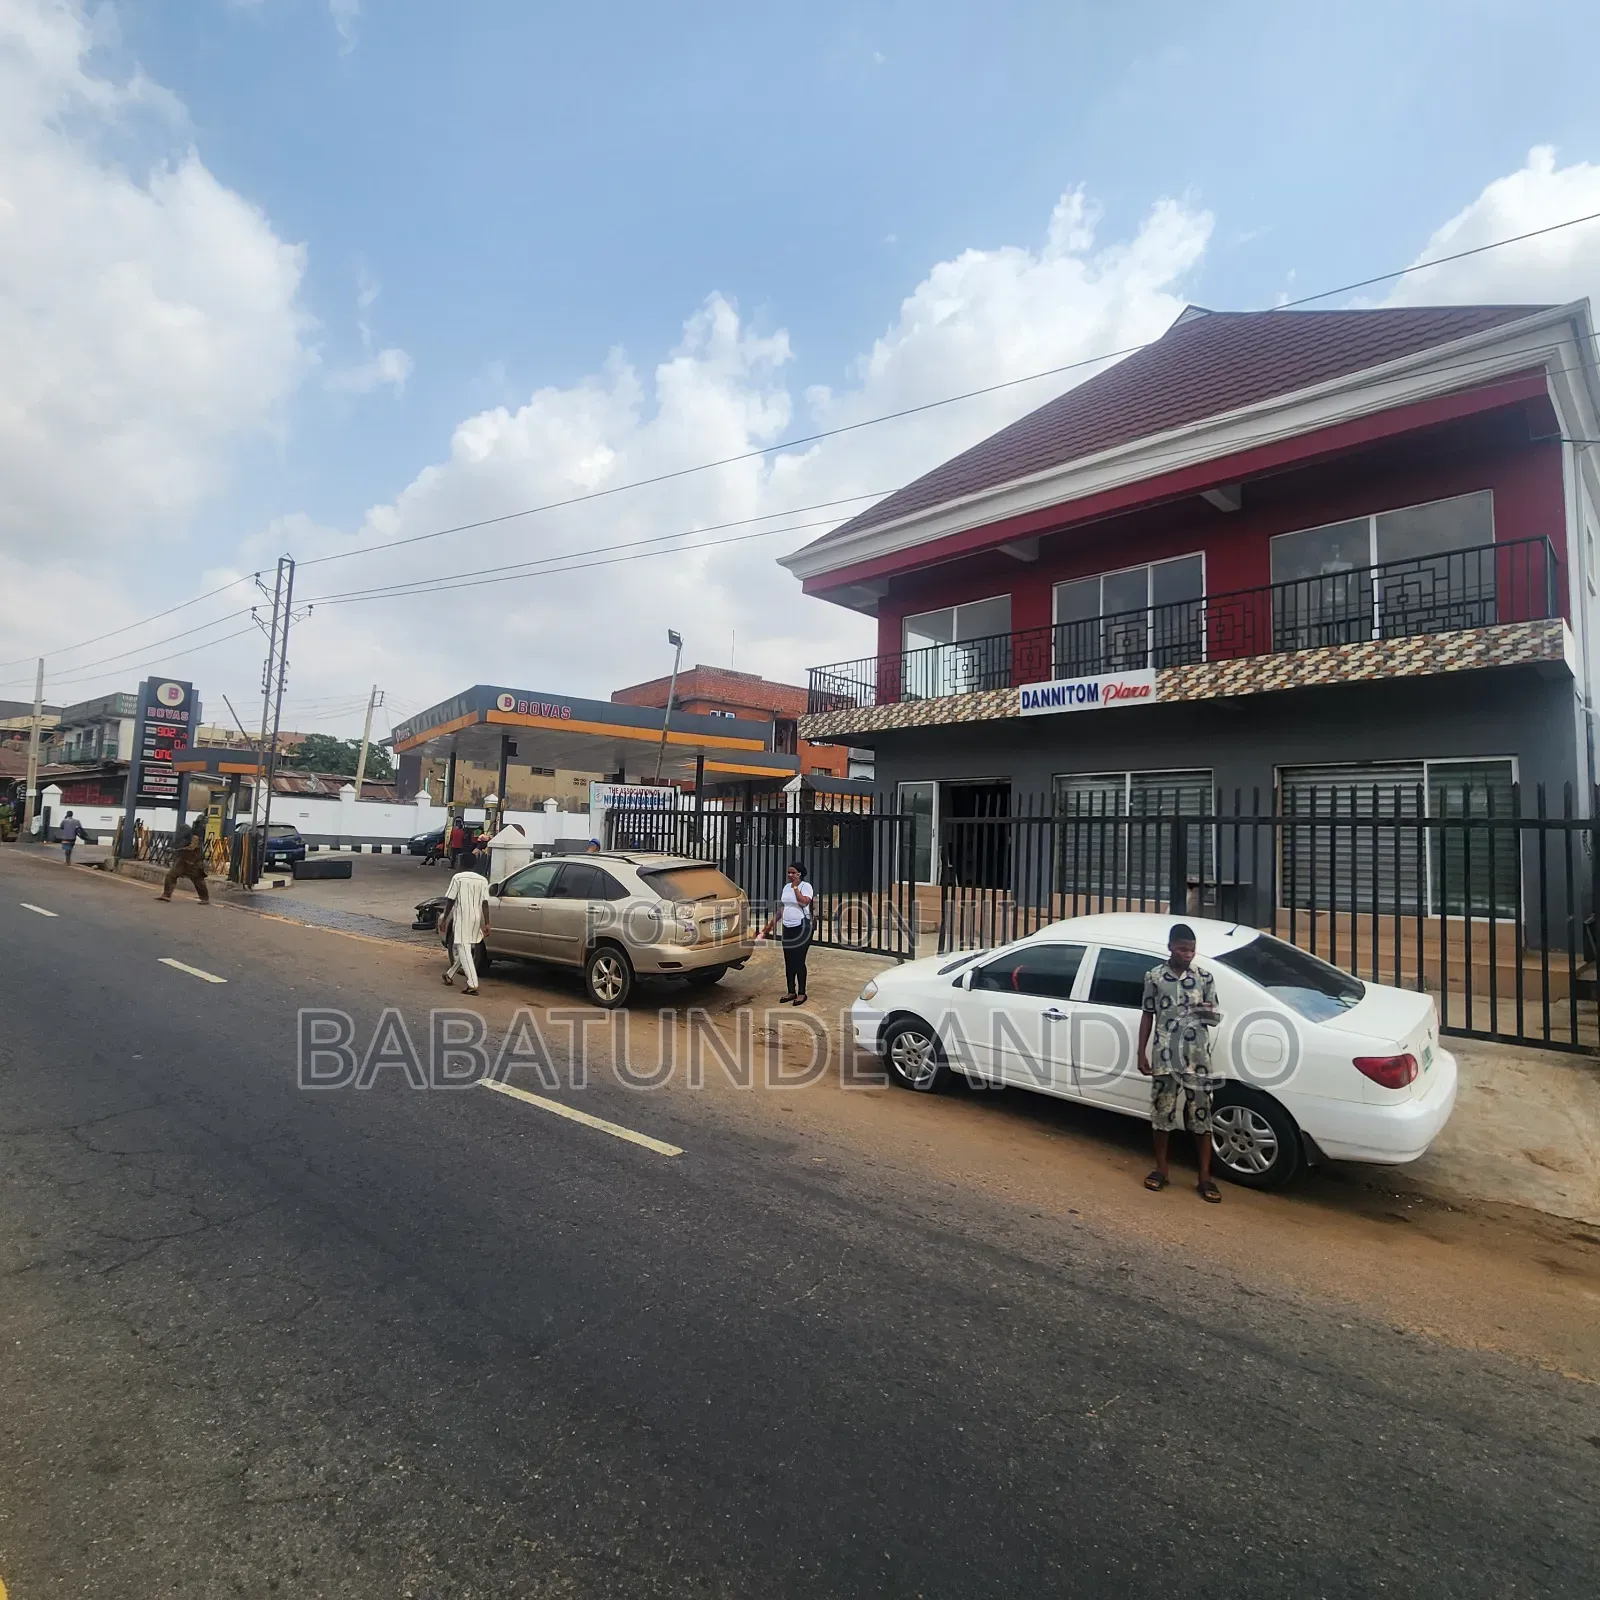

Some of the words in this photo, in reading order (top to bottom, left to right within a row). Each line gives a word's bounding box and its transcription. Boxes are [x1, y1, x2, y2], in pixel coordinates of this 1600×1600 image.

[168, 687, 179, 700] B
[1021, 682, 1099, 709] DANNITOM
[1102, 681, 1151, 706] Plaza
[147, 706, 189, 721] BOVAS
[504, 696, 513, 708] B
[517, 700, 571, 720] BOVAS
